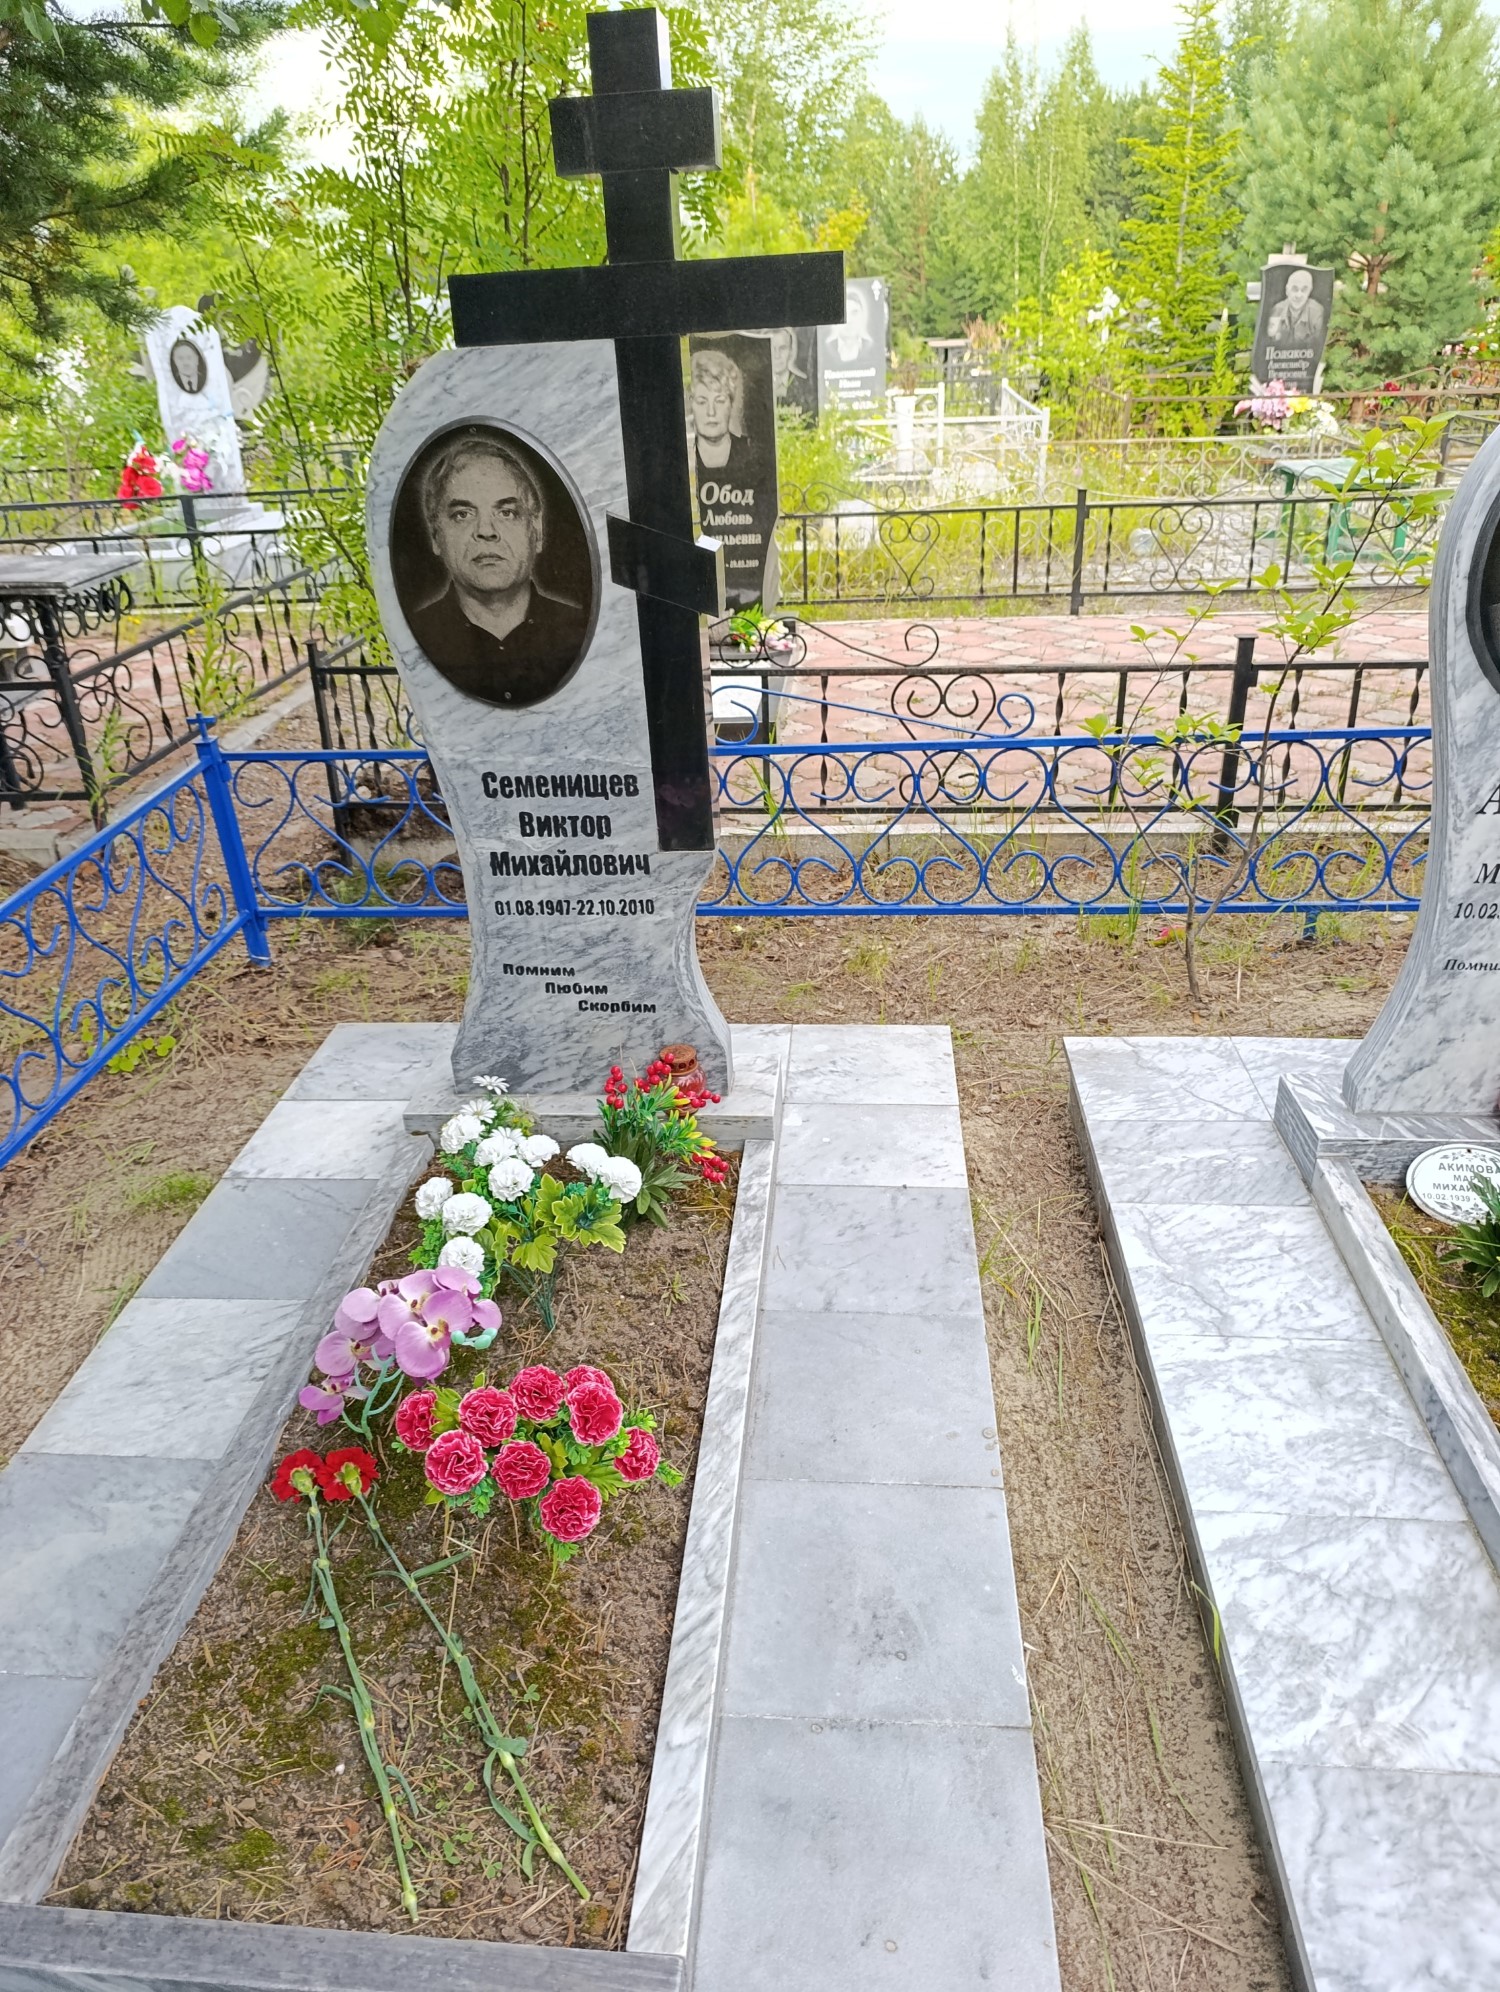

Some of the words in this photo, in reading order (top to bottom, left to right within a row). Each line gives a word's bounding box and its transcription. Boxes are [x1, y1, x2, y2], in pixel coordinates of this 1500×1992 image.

[700, 481, 754, 506] Обод
[702, 509, 753, 526] Любовь
[711, 533, 762, 545] ильевна
[481, 771, 640, 800] Семенищев
[518, 811, 613, 839] Виктор
[489, 849, 651, 876] Михайлович
[494, 898, 655, 917] 01.08.1947-22.10.2010
[502, 962, 576, 977] Помним
[577, 999, 657, 1014] Скорбим
[1422, 1192, 1471, 1202] 10.02.1939
